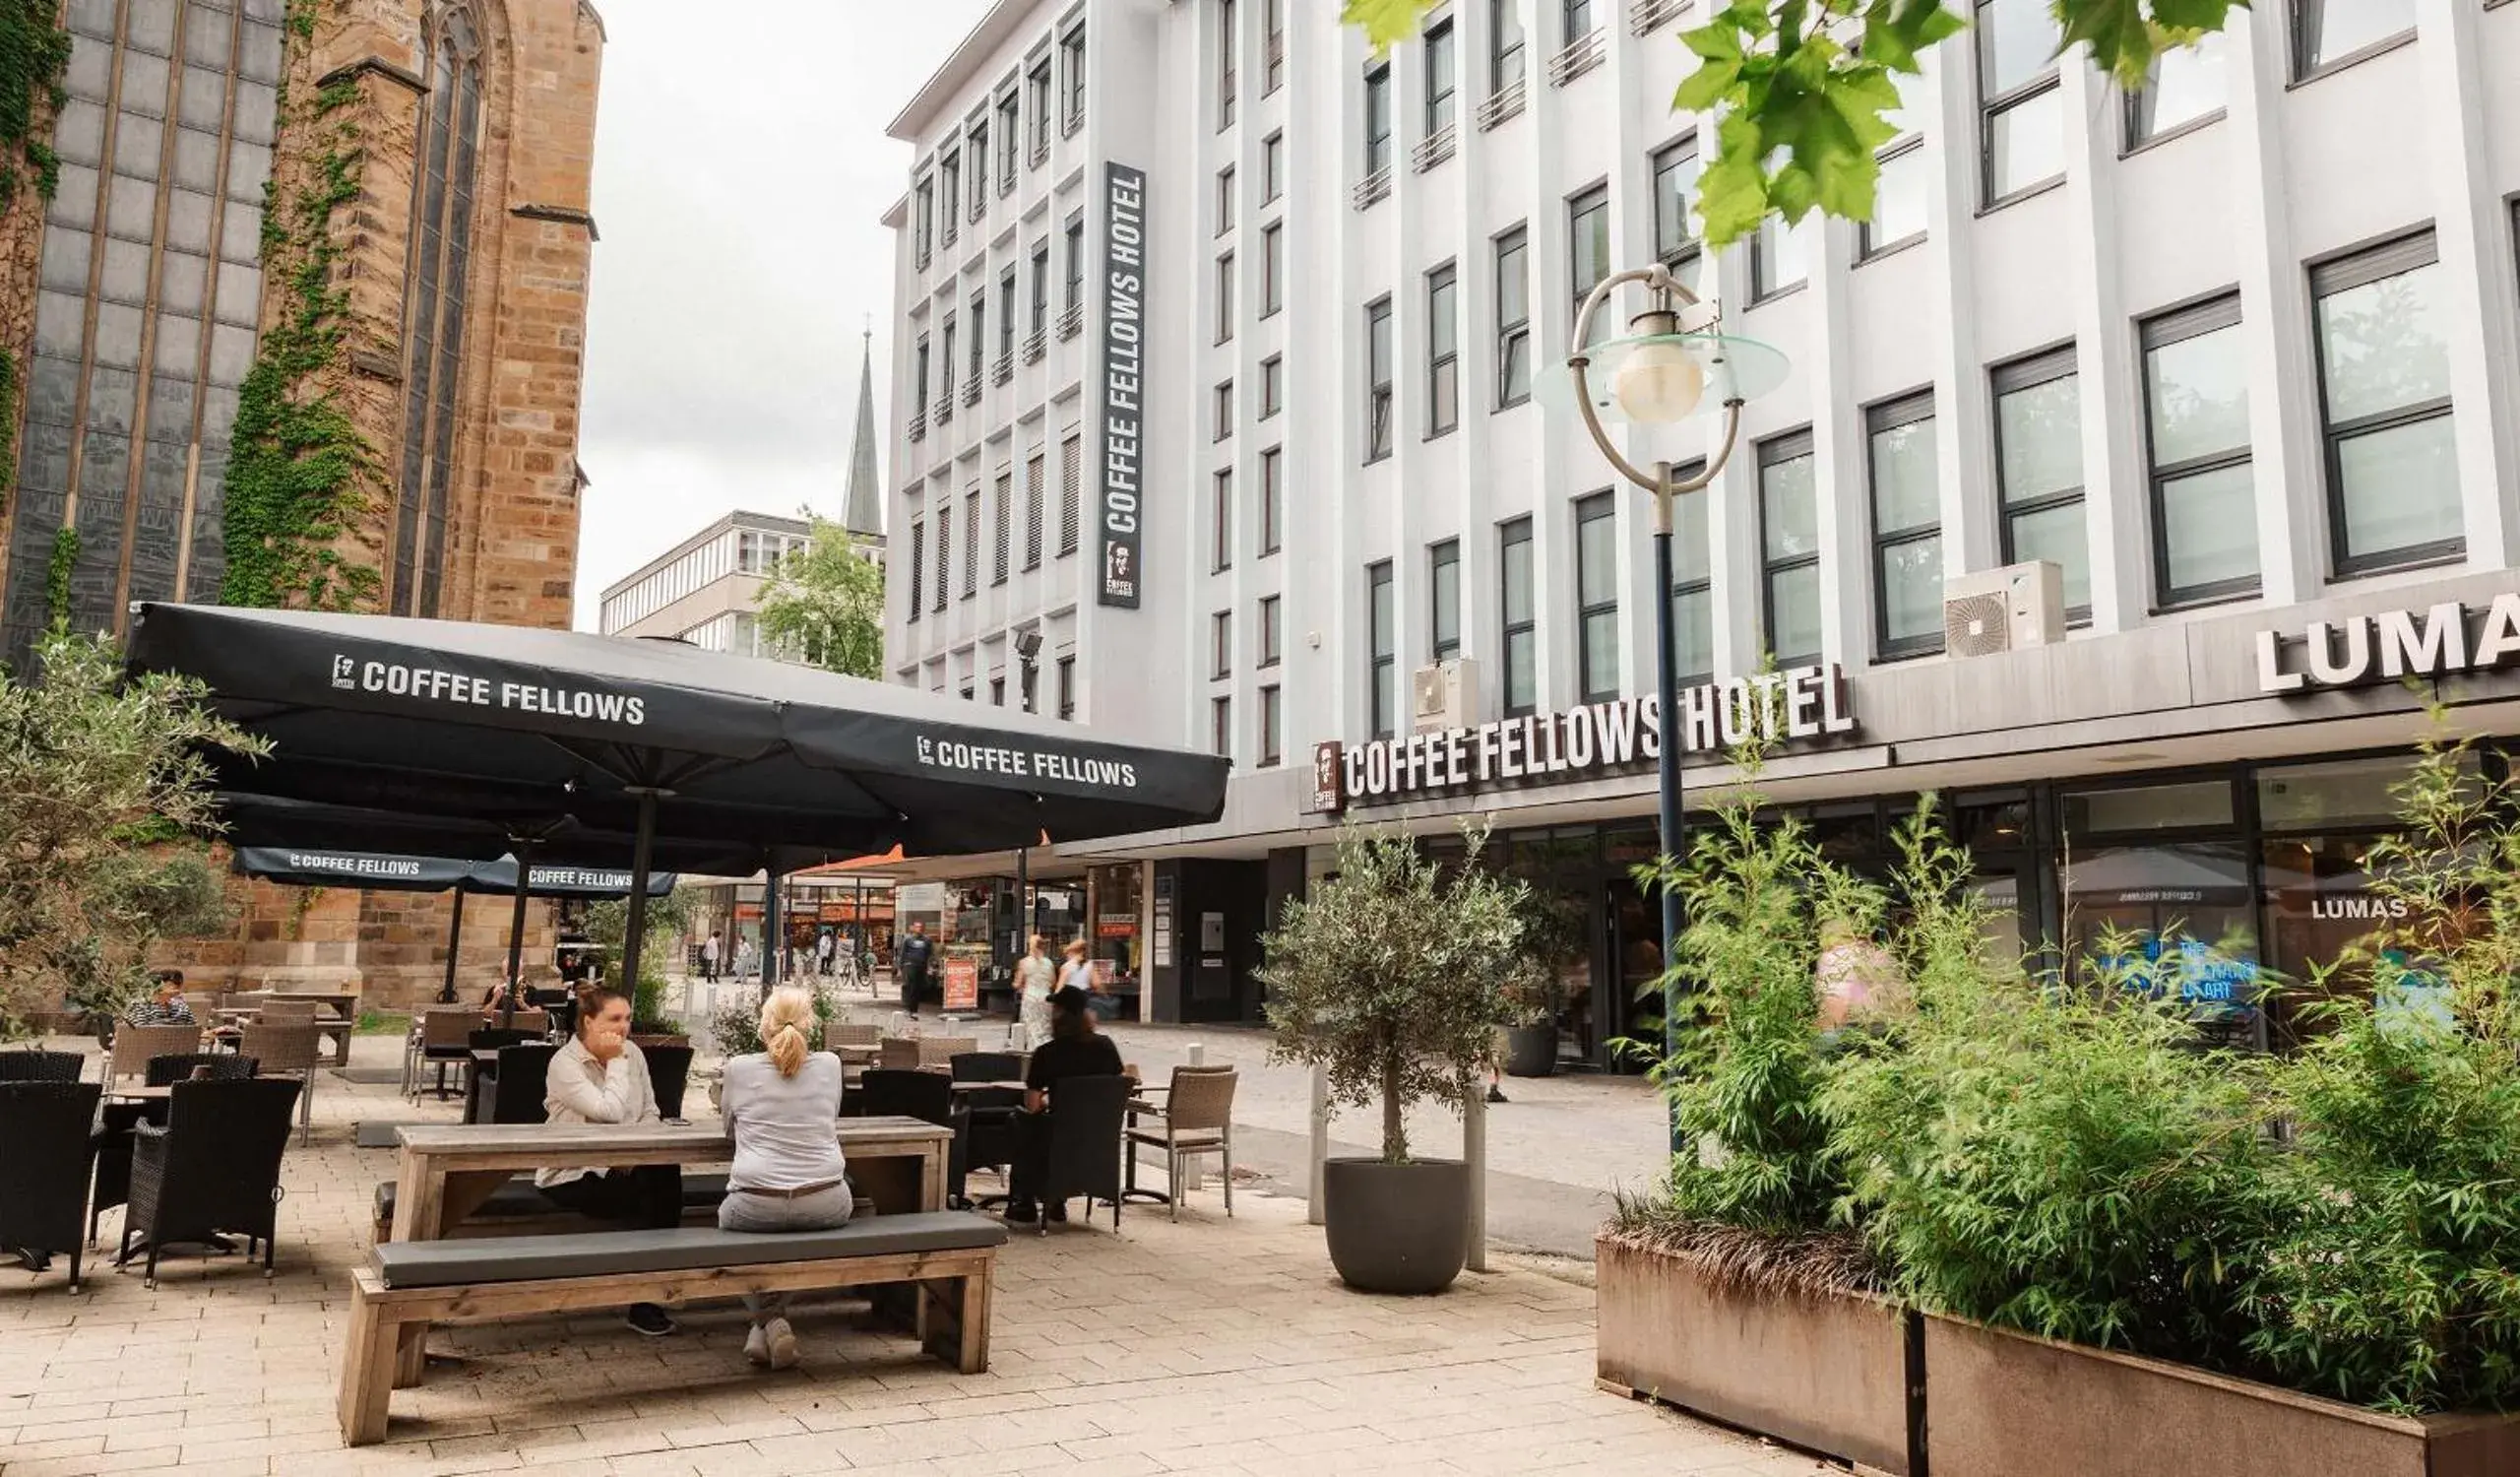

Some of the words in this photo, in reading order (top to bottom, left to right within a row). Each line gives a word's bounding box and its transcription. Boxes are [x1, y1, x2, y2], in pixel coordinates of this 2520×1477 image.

[1111, 176, 1140, 266] HOTEL
[1109, 272, 1140, 411] FELLOWS
[1106, 417, 1137, 533] COFFEE
[362, 661, 490, 706] COFFEE
[501, 682, 645, 726] FELLOWS
[1346, 727, 1471, 798] COFFEE
[1480, 692, 1660, 782] FELLOWS
[1684, 662, 1855, 751] HOTEL
[937, 740, 1028, 776] COFFEE
[1034, 752, 1137, 788] FELLOWS
[302, 855, 354, 871] COFFEE
[357, 859, 419, 874] FELLOWS
[529, 869, 575, 884] COFFEE
[578, 871, 633, 886] FELLOWS
[2311, 898, 2409, 919] LUMAS
